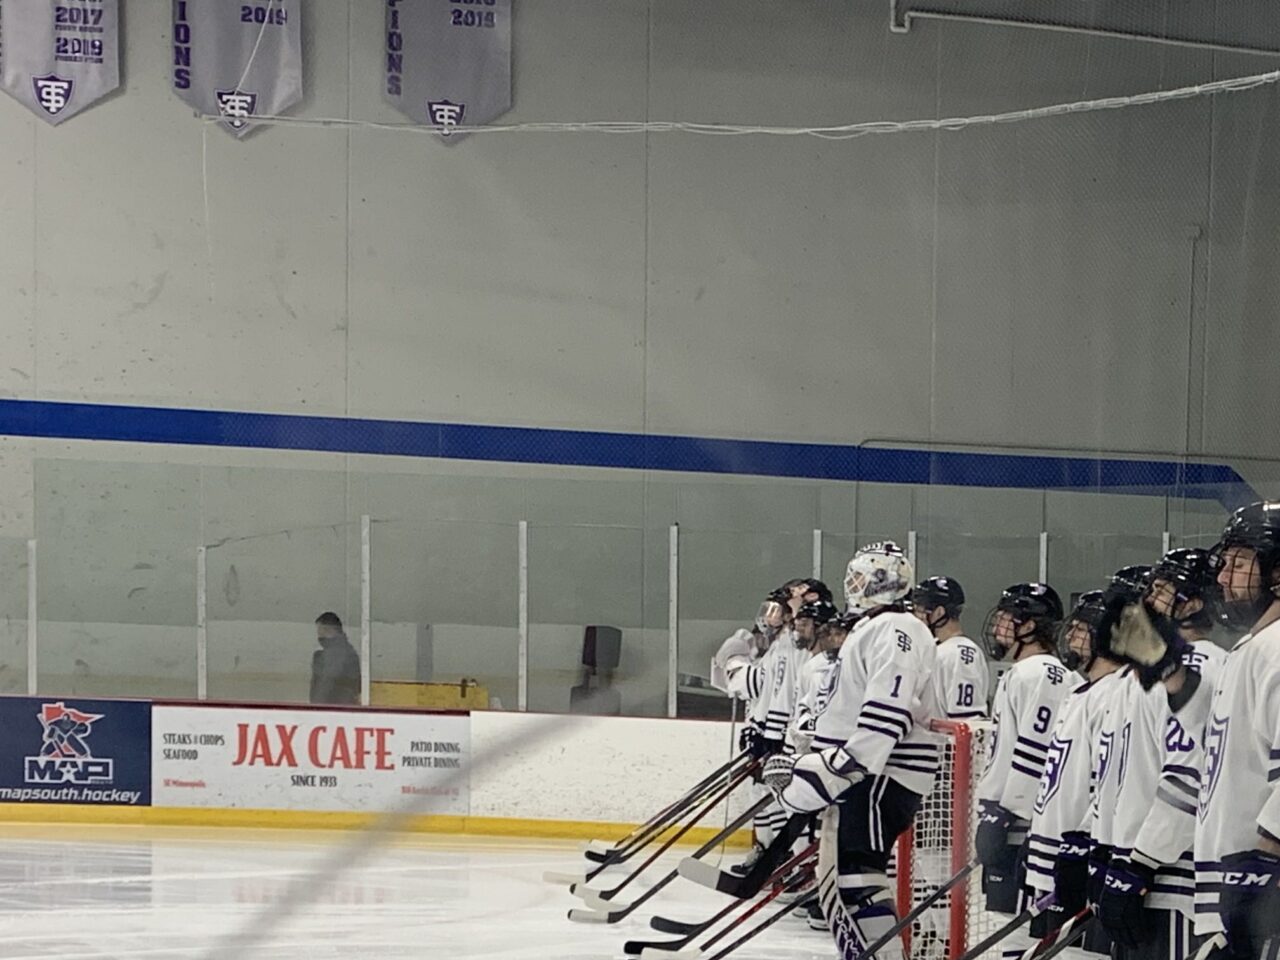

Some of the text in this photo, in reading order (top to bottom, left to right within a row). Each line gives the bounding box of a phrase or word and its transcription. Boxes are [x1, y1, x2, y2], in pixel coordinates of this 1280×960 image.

[55, 6, 103, 25] 2017
[240, 6, 288, 26] 2019
[55, 37, 103, 56] 2019
[890, 674, 903, 698] 1
[956, 683, 975, 708] 18
[1033, 706, 1051, 734] 9
[163, 733, 192, 745] STEAKS
[199, 734, 225, 746] CHOPS
[231, 723, 395, 771] JAX CAFE
[410, 741, 461, 754] PATIO DINING
[163, 748, 198, 760] SEAFOOD
[401, 756, 432, 768] PRIVATE
[291, 774, 338, 788] SINCE 1933
[0, 787, 141, 804] mapsouth.hockey
